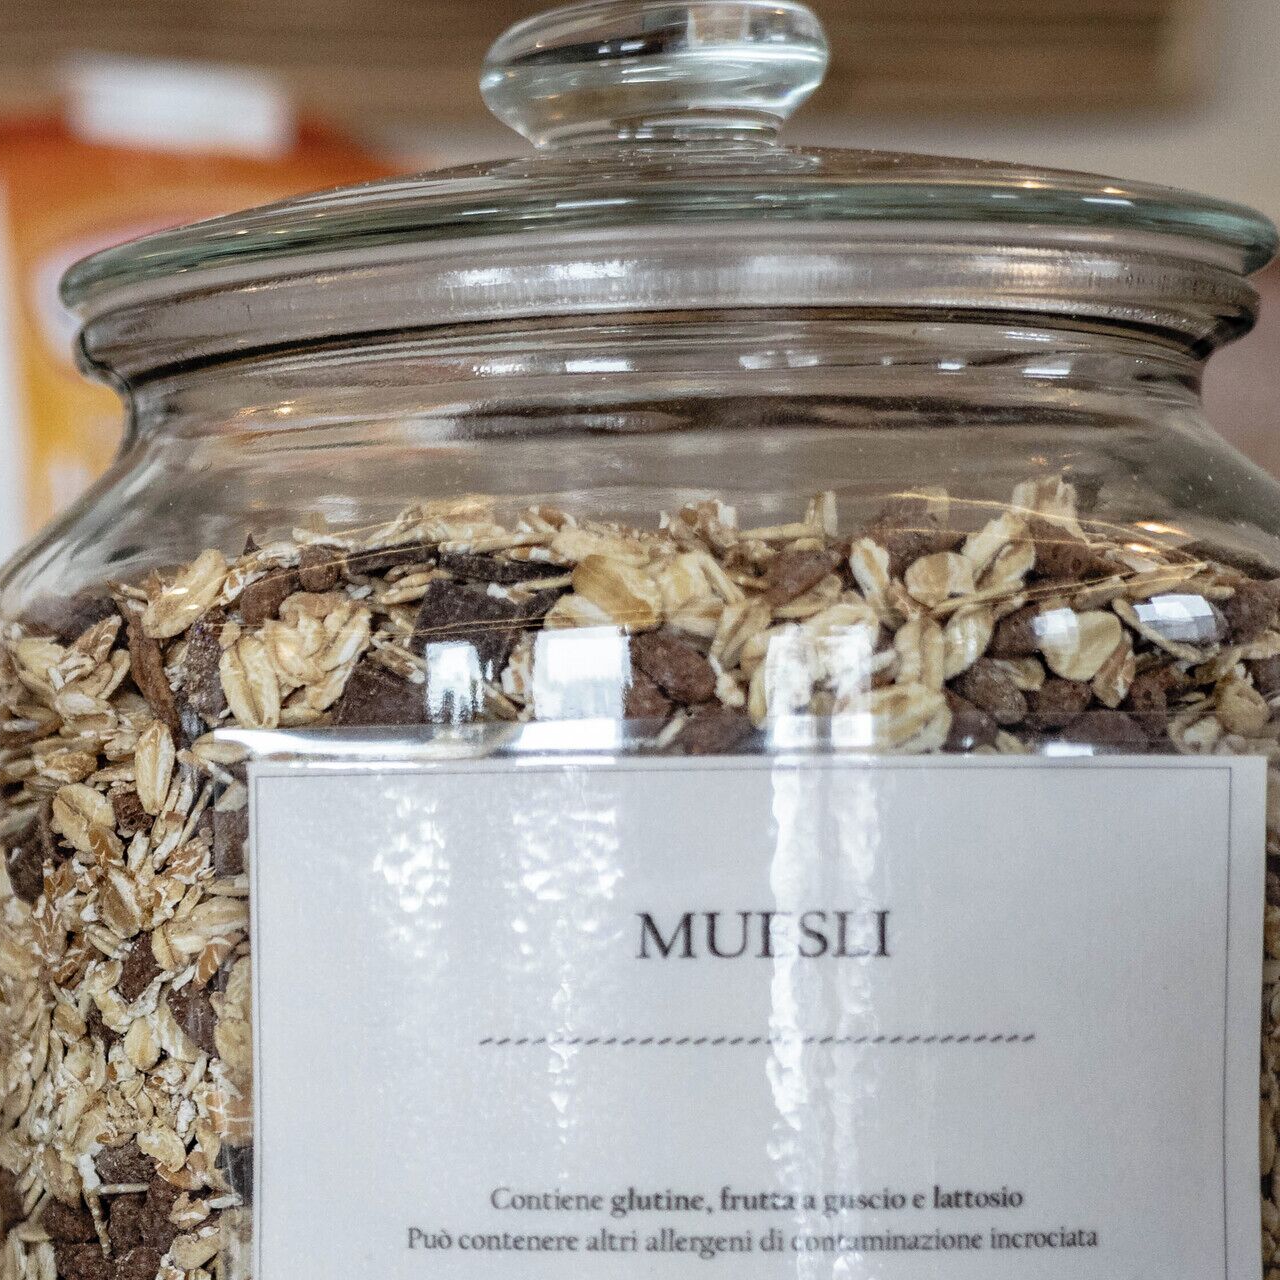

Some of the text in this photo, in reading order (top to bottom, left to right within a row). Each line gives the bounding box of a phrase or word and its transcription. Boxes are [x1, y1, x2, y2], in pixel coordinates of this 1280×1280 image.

[489, 1184, 1025, 1219] Contiene glutine, frutta a guscio e lattosio
[406, 1225, 1100, 1260] Può contenere altri allergeni di contaminazione incrociata
